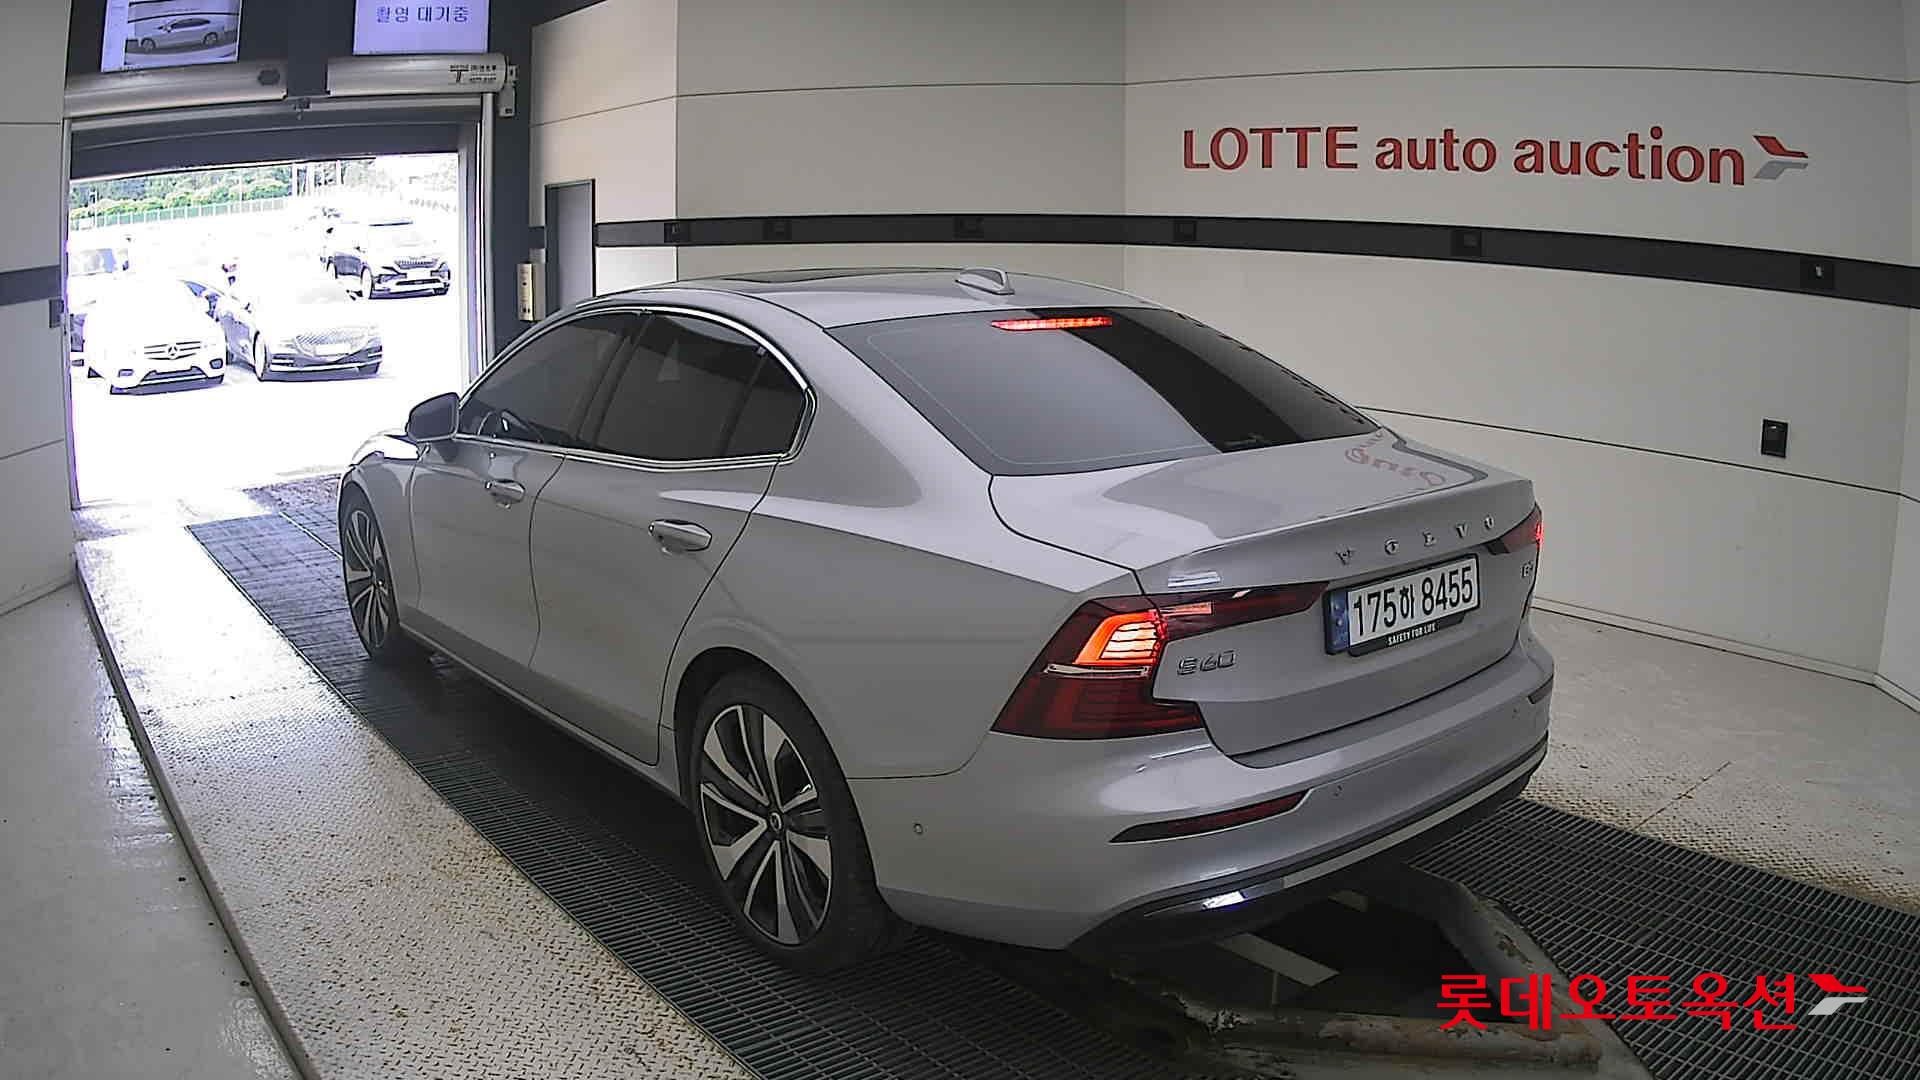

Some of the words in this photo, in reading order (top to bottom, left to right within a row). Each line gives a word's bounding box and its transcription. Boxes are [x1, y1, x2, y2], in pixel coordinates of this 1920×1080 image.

[417, 5, 469, 23] 대기중
[1183, 126, 1359, 170] LOTTE
[1375, 128, 1497, 172] auto
[1513, 126, 1745, 186] auction
[1336, 514, 1495, 566] VOLVO
[1352, 583, 1415, 637] 175하
[1421, 566, 1474, 616] 8455
[1387, 629, 1411, 646] SAFETY
[1411, 627, 1424, 640] FOR
[1176, 649, 1237, 676] S60
